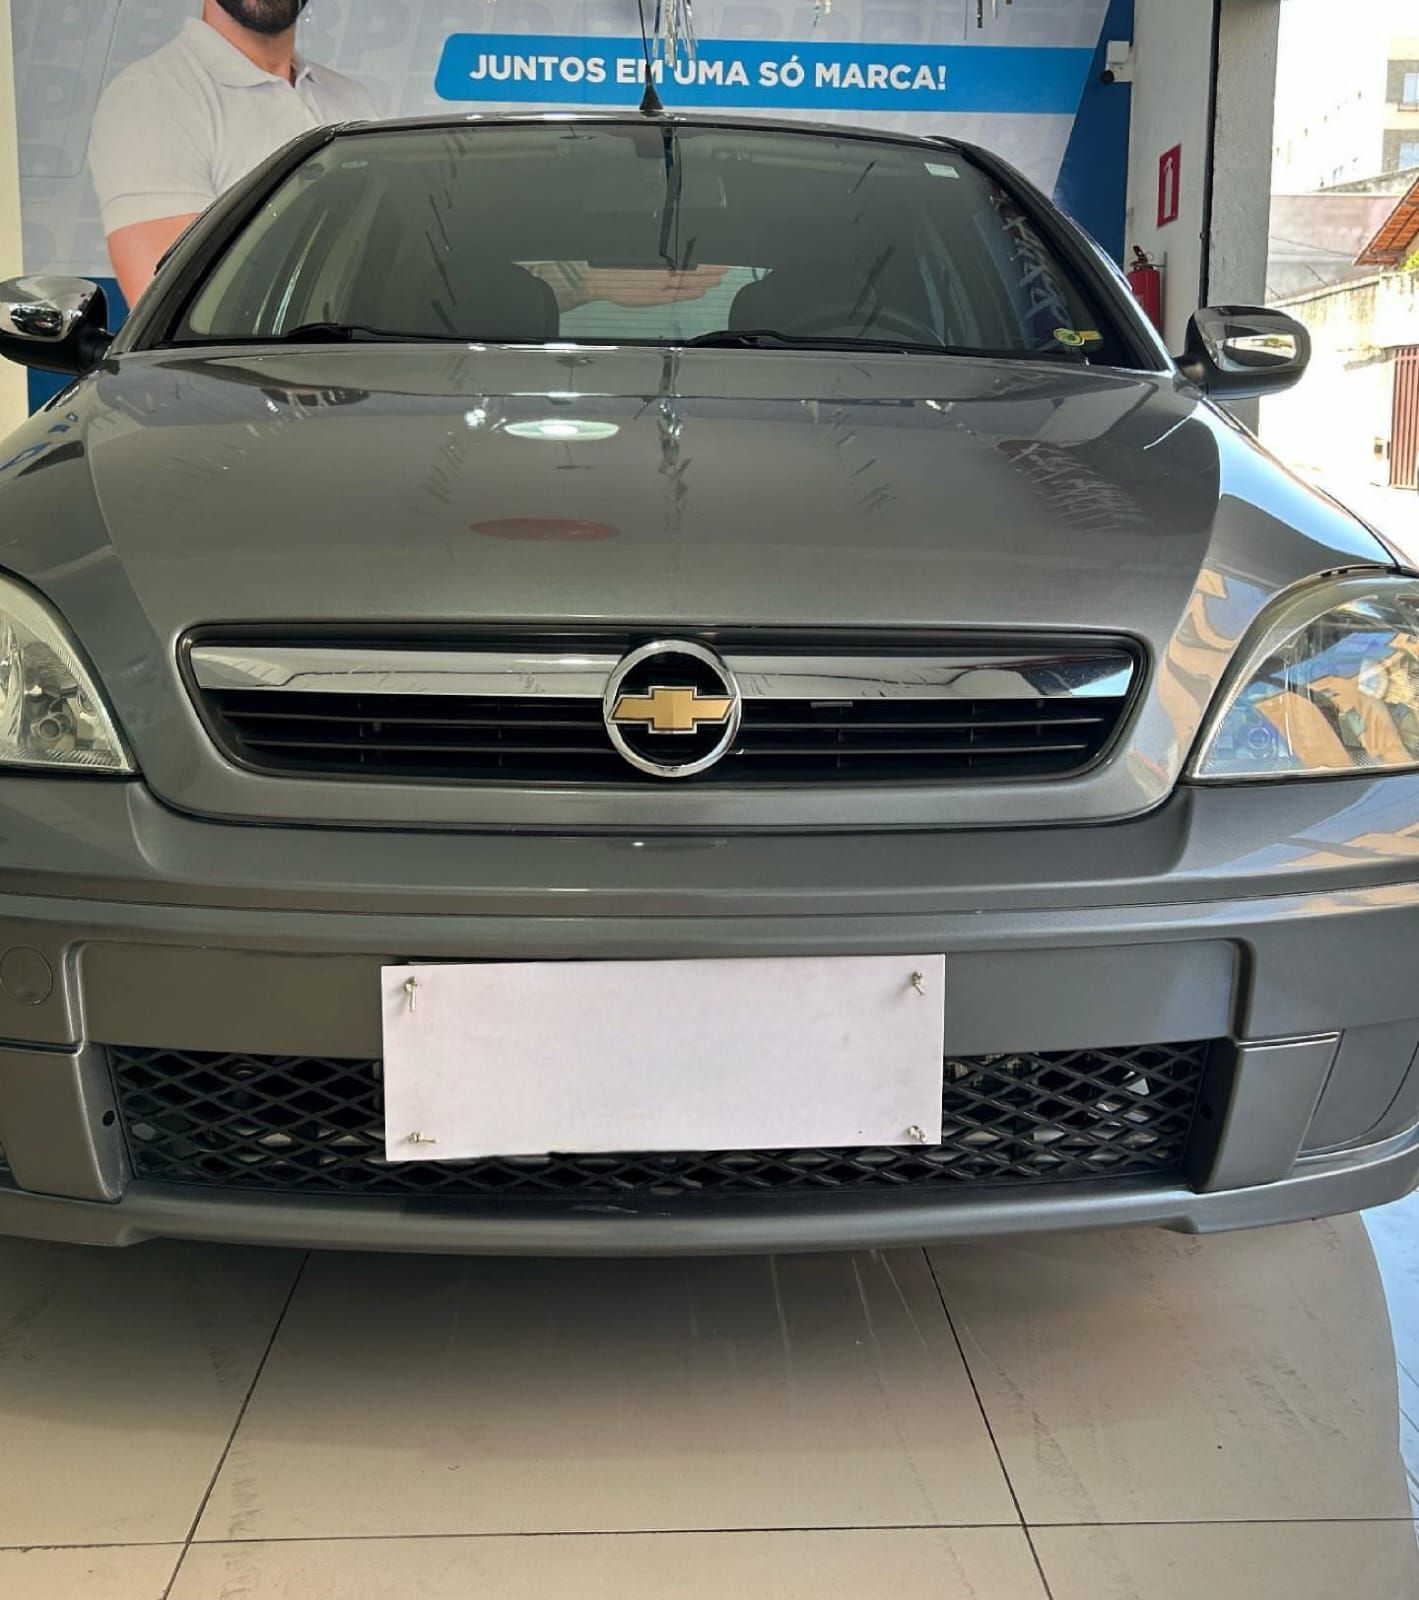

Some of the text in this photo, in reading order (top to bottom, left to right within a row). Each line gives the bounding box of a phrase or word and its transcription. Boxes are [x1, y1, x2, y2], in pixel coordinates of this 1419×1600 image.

[469, 54, 947, 90] JUNTOS EM UMA SÓ MARCA!
